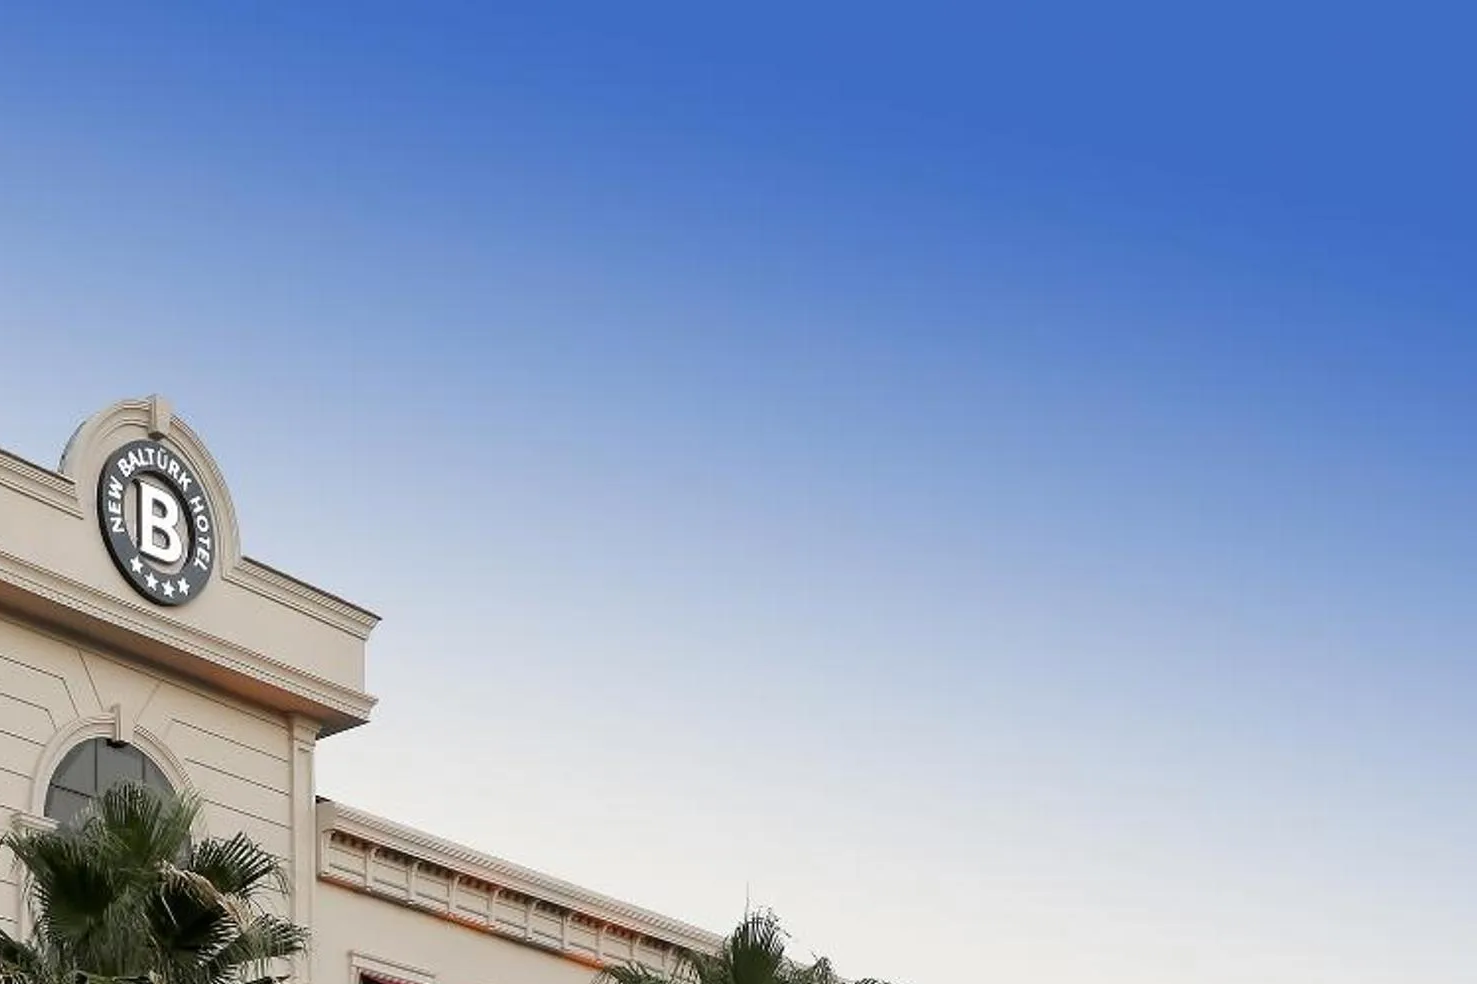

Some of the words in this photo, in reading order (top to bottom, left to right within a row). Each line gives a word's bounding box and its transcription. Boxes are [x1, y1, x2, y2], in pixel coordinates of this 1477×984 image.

[107, 475, 126, 533] NEW
[117, 447, 193, 492] BALTÜRK
[189, 496, 211, 571] HOTEL
[139, 481, 184, 563] B
